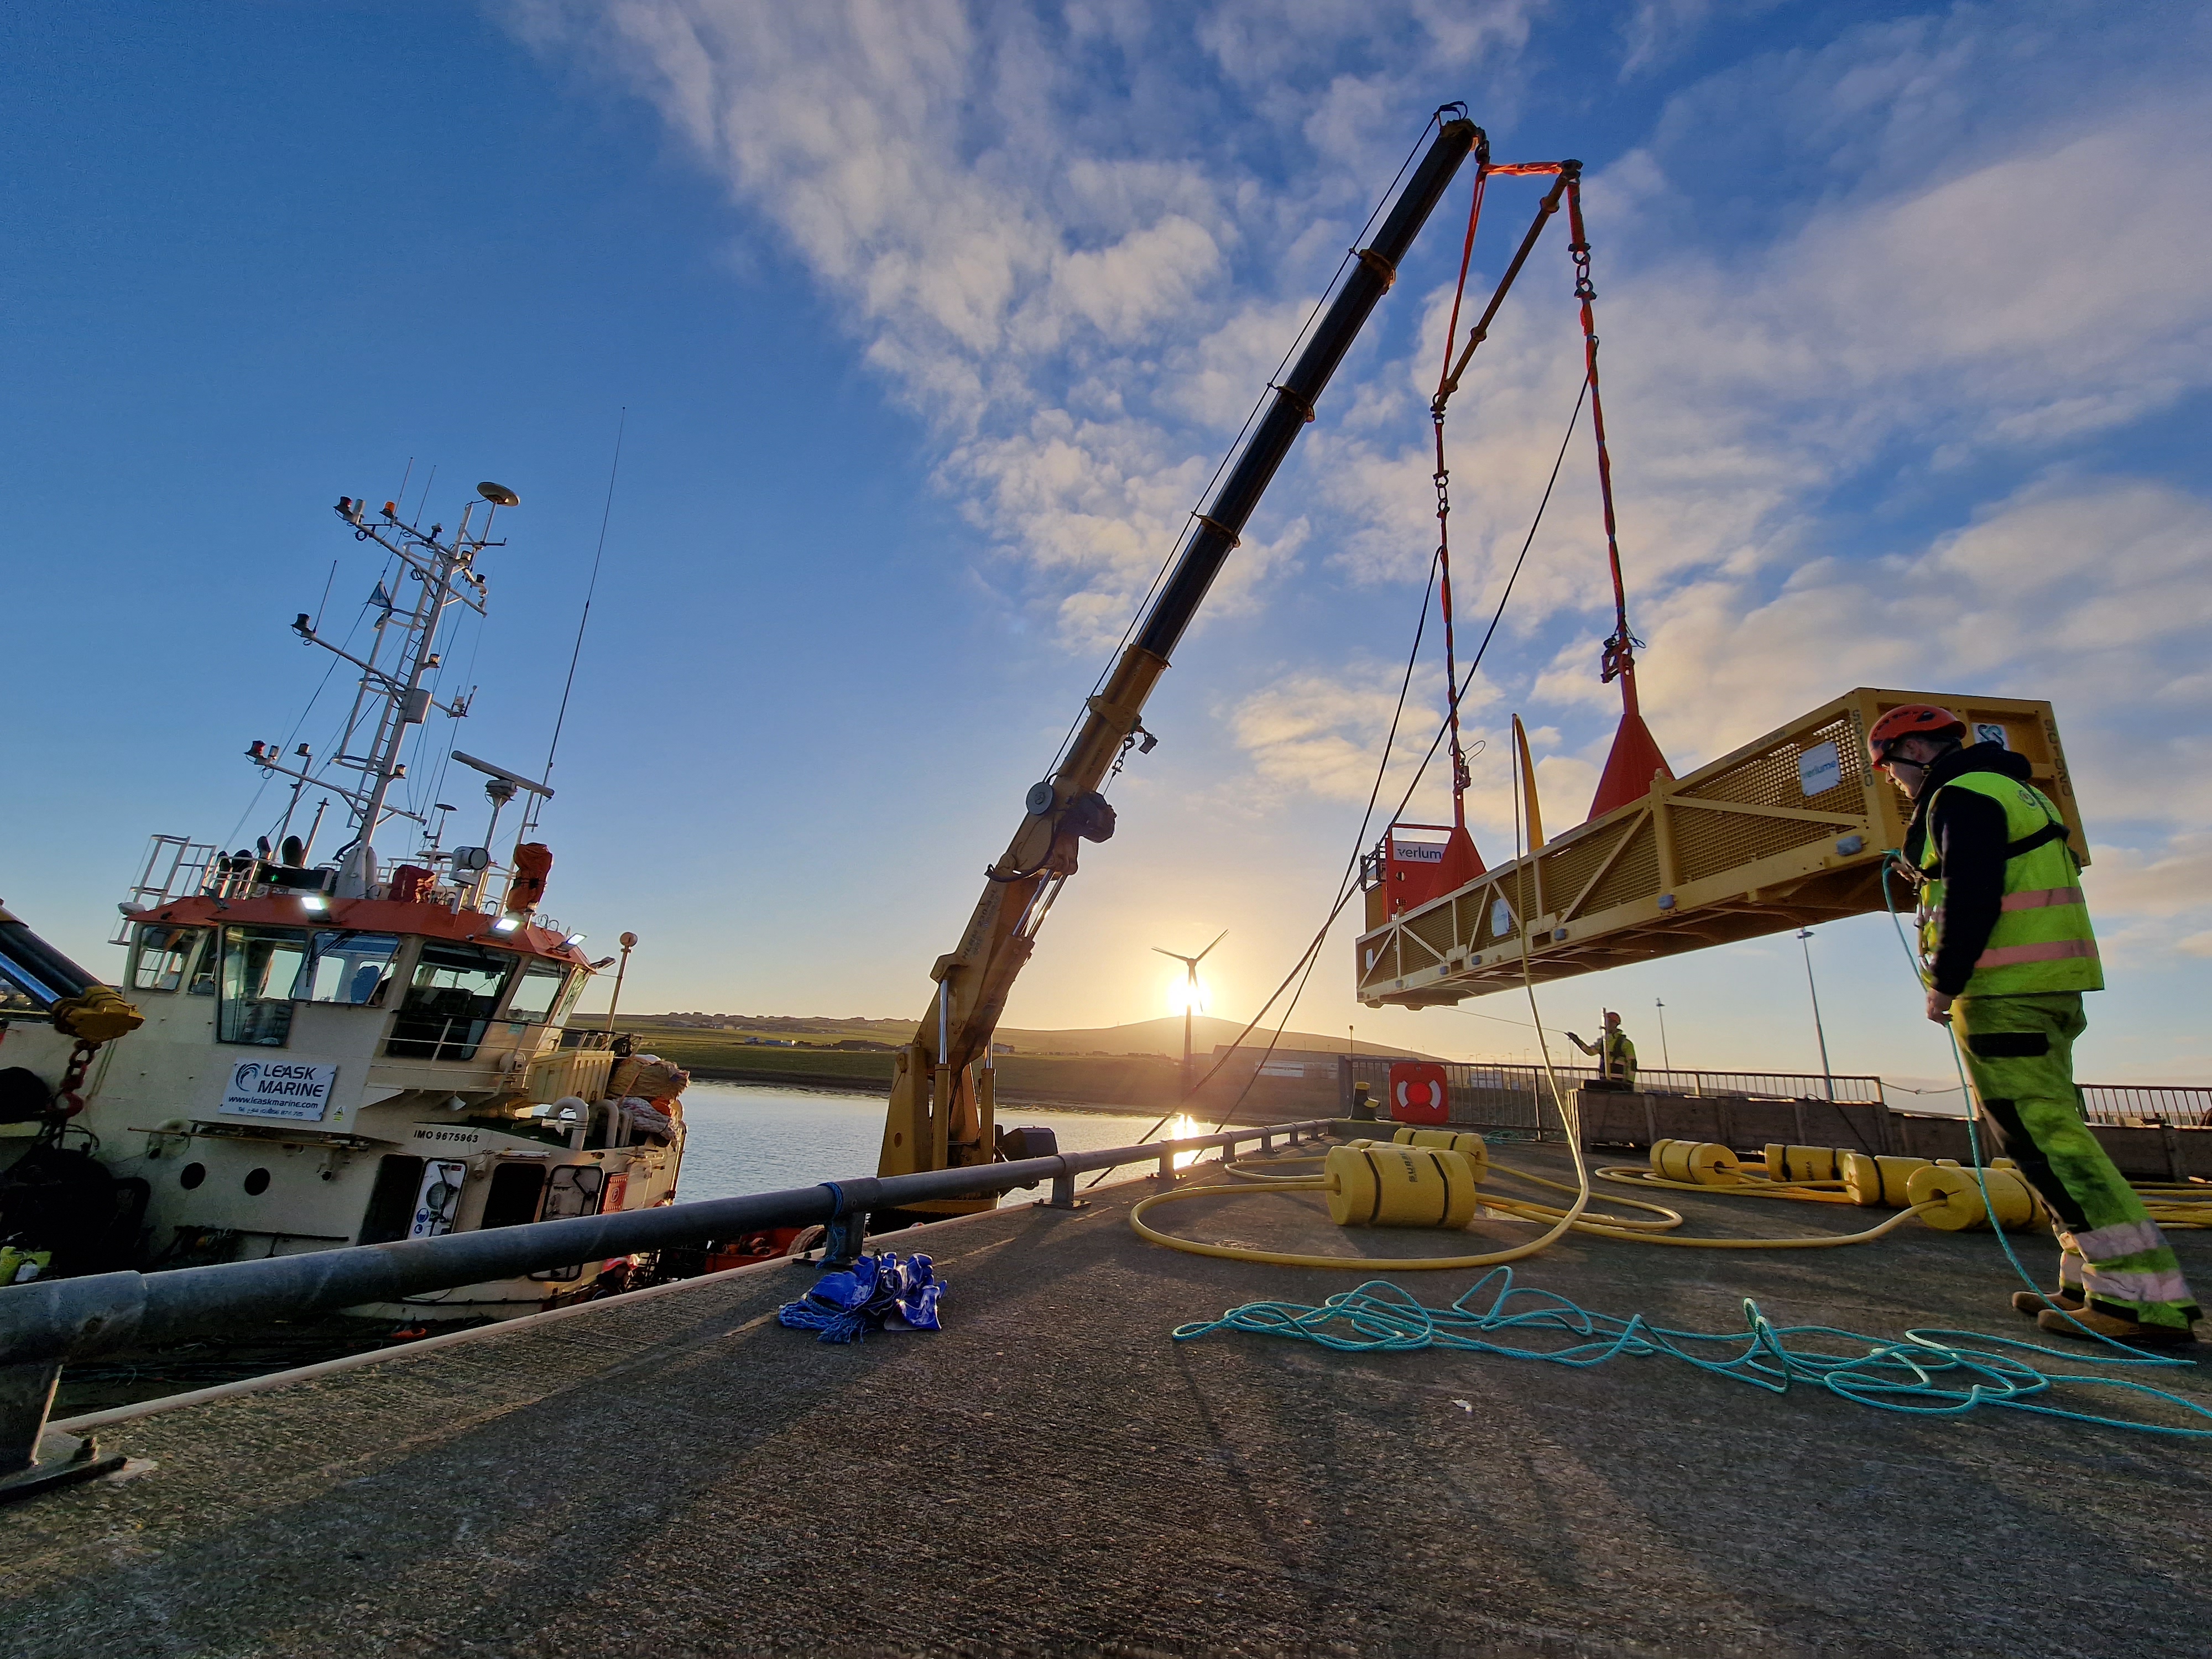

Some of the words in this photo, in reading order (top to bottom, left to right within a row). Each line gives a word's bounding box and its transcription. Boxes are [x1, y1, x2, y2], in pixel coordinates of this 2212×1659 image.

[1397, 846, 1442, 859] verlum
[263, 1063, 317, 1080] LEASK
[257, 1080, 324, 1097] MARINE
[228, 1096, 318, 1109] www.leaskmarine.com
[414, 1130, 433, 1139] IMO
[436, 1131, 479, 1143] 9675963
